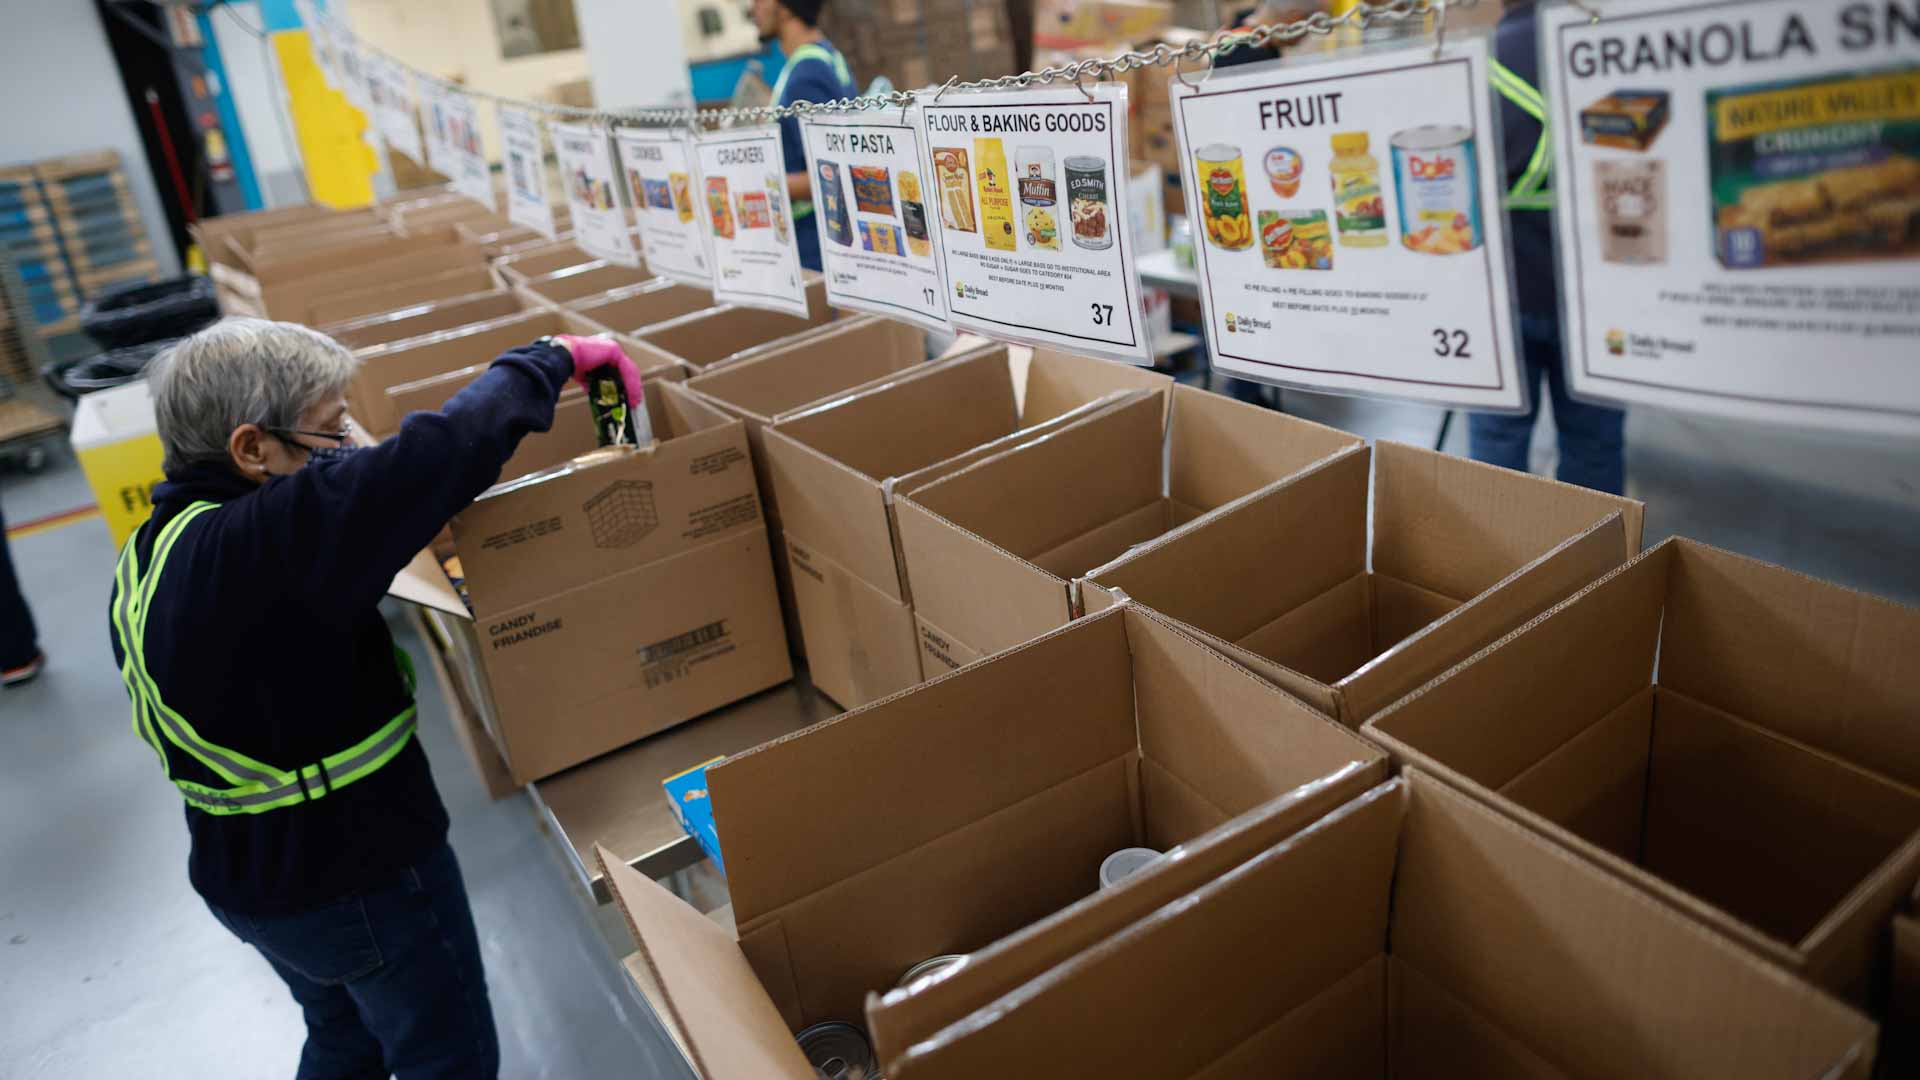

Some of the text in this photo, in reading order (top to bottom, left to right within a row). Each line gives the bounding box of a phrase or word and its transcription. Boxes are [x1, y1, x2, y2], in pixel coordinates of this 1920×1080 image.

[1568, 13, 1817, 78] GRANOLA
[928, 113, 1106, 132] FLOUR & BAKING GOODS
[1259, 92, 1342, 130] FRUIT
[717, 147, 765, 165] CRACKERS
[825, 133, 895, 155] DRY PASTA
[1408, 155, 1456, 181] Dole
[1023, 182, 1050, 197] Muffin
[923, 286, 935, 306] 17
[1091, 303, 1113, 326] 37
[1433, 328, 1471, 358] 32
[489, 612, 536, 637] CANDY
[493, 618, 562, 650] FRIANDISE
